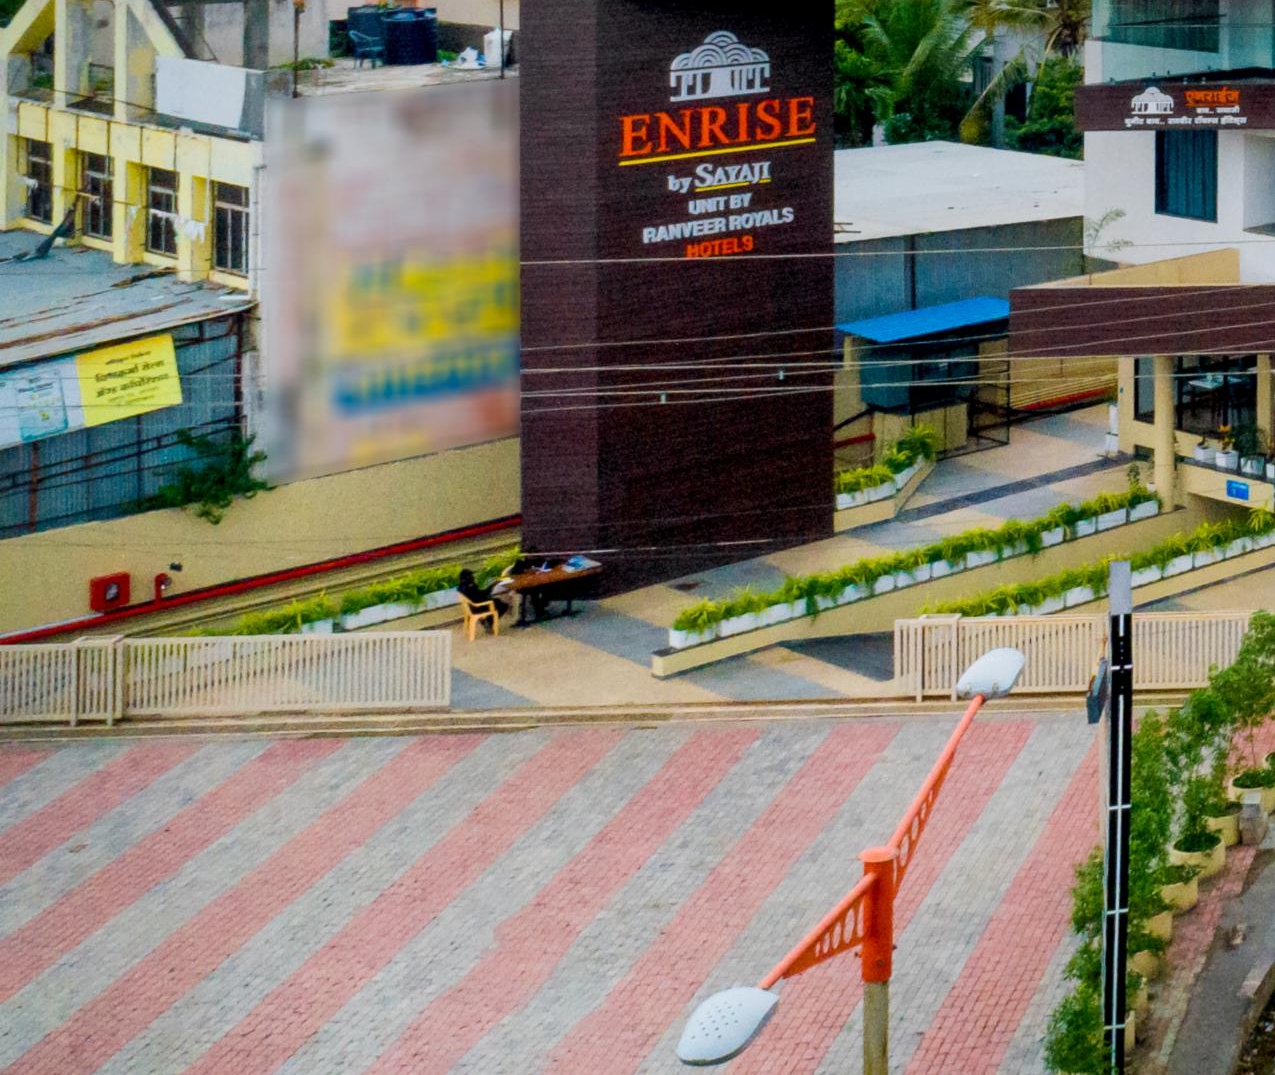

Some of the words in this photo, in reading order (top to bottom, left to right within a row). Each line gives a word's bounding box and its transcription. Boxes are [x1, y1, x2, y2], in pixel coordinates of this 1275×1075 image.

[618, 96, 817, 158] ENRISE
[667, 175, 692, 193] by
[695, 161, 771, 187] SAYAJI
[688, 196, 728, 215] UNIT
[730, 193, 752, 209] BY
[643, 217, 727, 244] RANVEER
[729, 207, 794, 230] ROYALS
[685, 235, 754, 260] HOTELS
